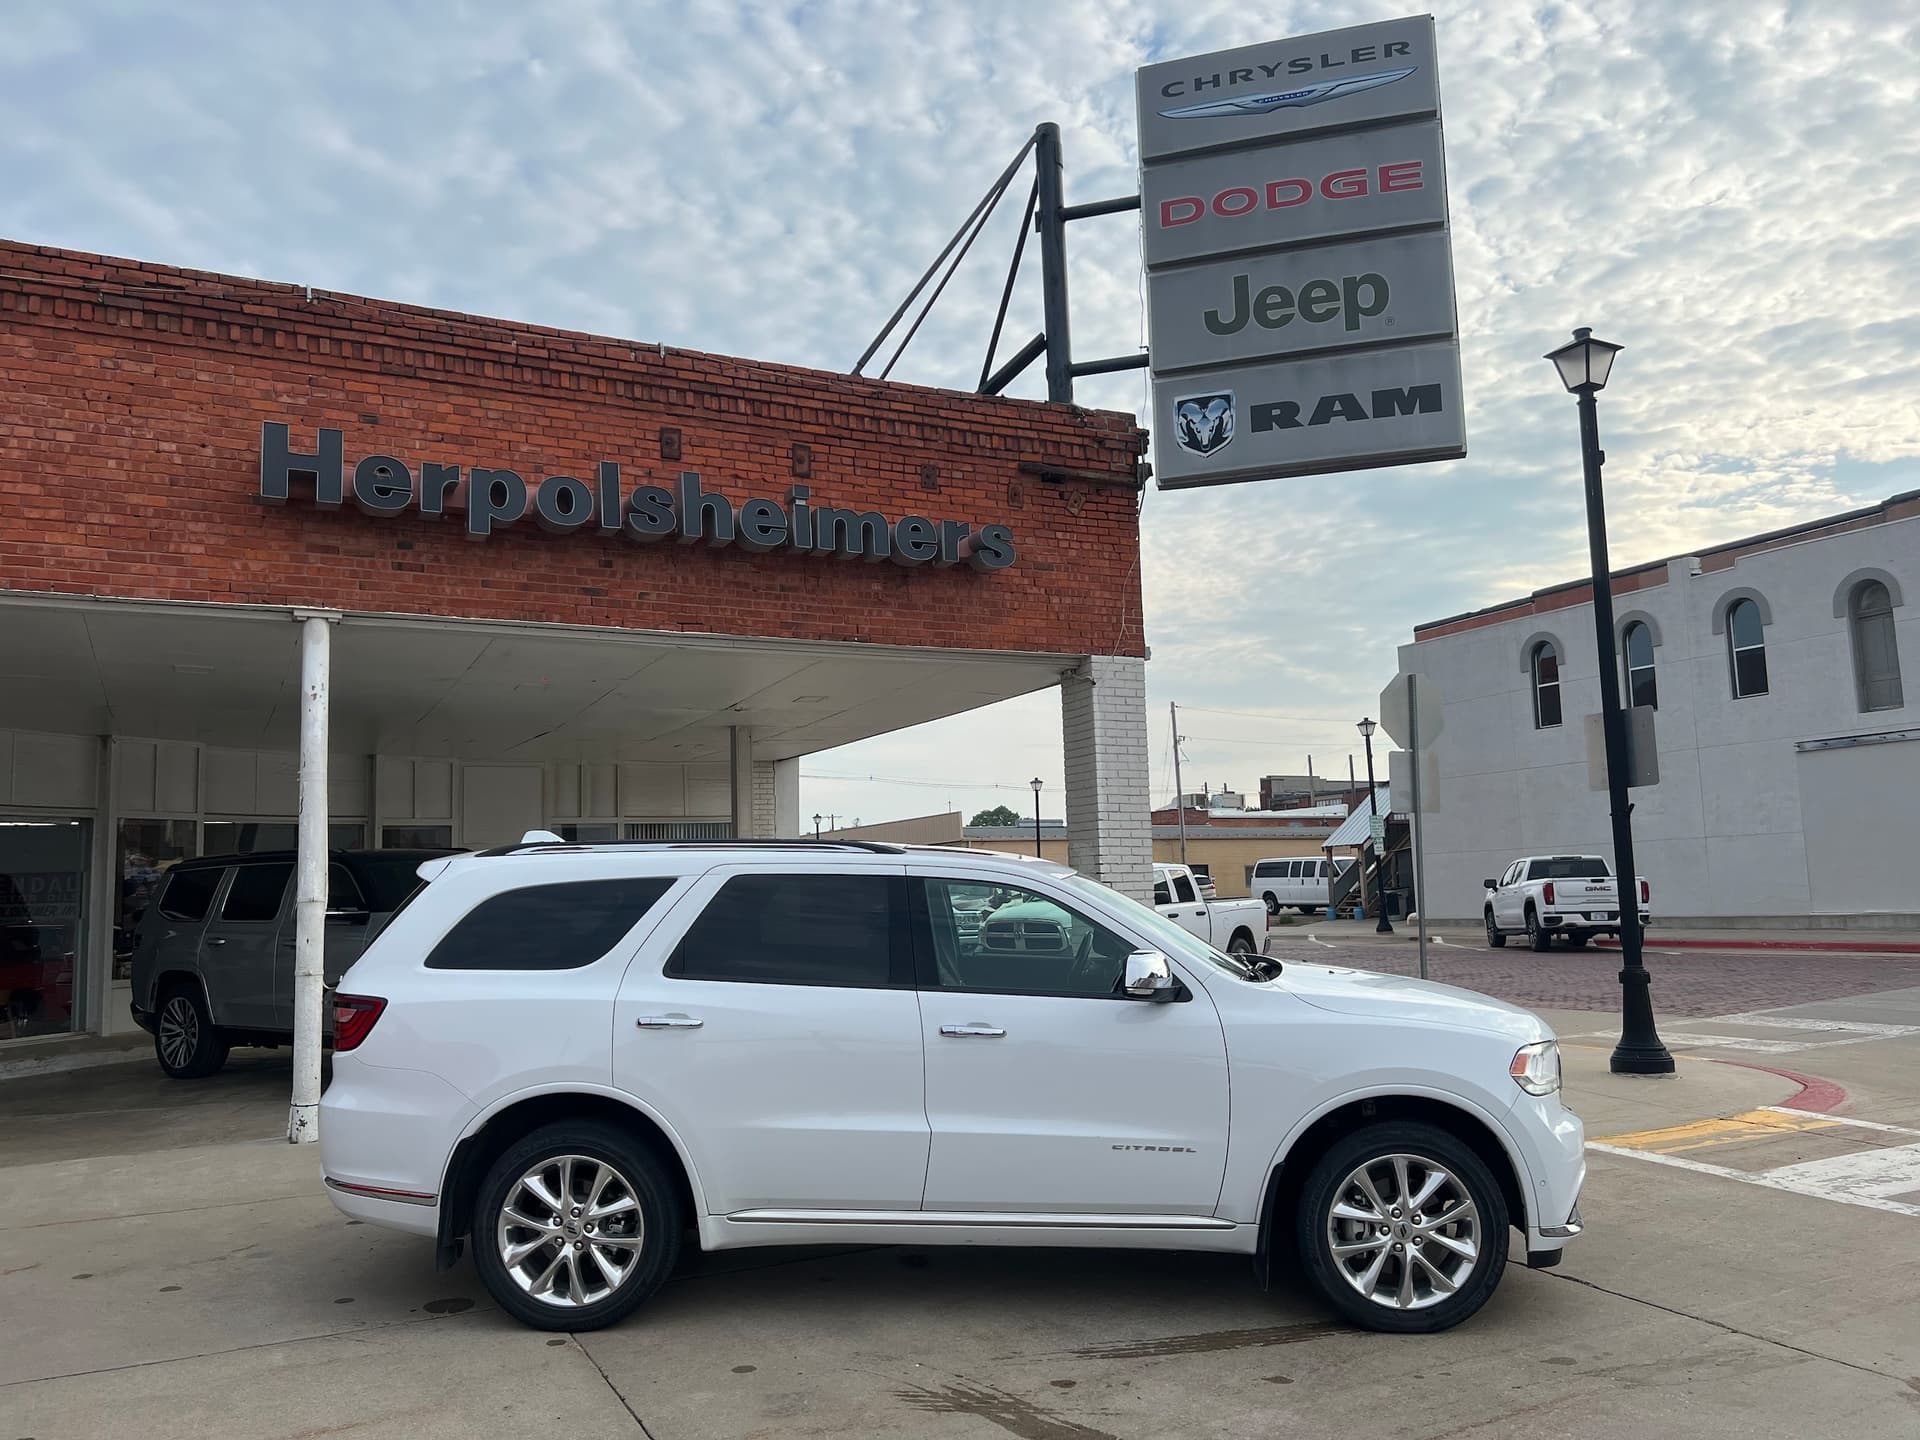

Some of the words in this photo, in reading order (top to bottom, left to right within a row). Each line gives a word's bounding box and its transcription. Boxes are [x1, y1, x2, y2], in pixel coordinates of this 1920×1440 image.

[1160, 41, 1413, 98] CHRYSLER
[1159, 161, 1425, 228] DODGE
[1203, 272, 1390, 336] Jeep
[1249, 383, 1444, 433] RAM
[259, 420, 1017, 570] Herpolsheimers
[1111, 1144, 1197, 1153] CITADEL
